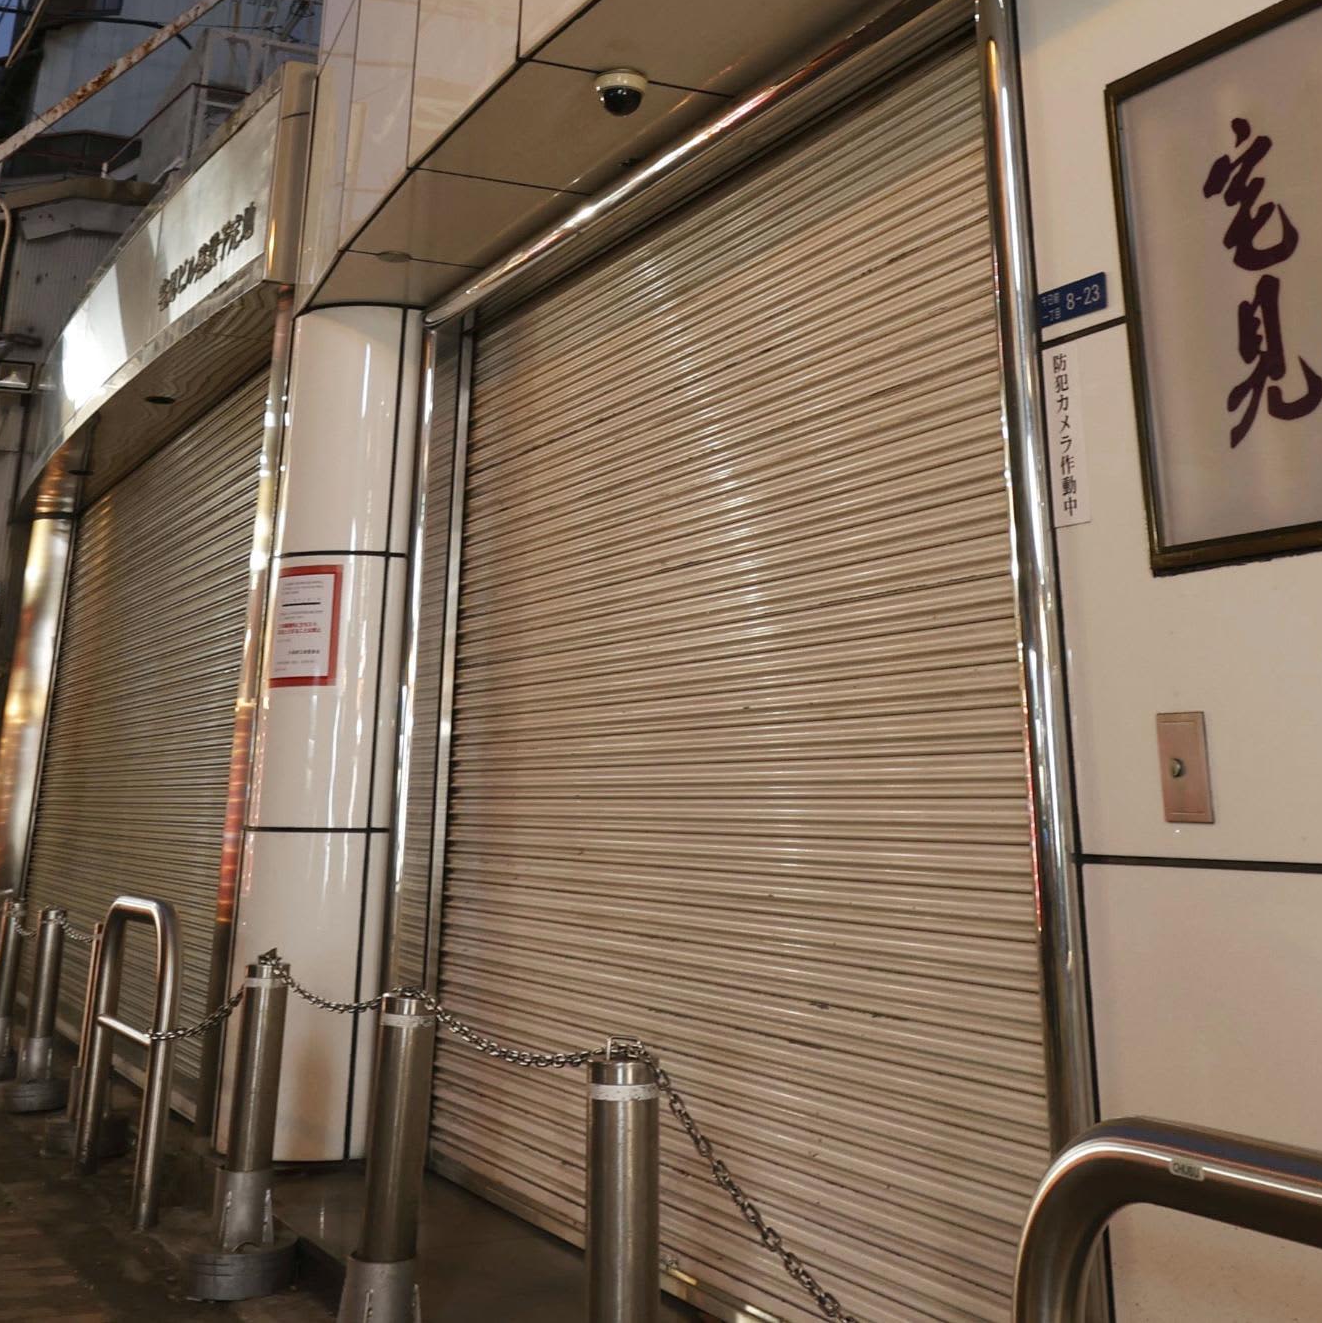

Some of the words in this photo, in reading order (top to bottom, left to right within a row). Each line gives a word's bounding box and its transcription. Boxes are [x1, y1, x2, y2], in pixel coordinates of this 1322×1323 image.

[1066, 283, 1101, 310] 8-23
[1052, 353, 1078, 517] 防犯カメラ作動中
